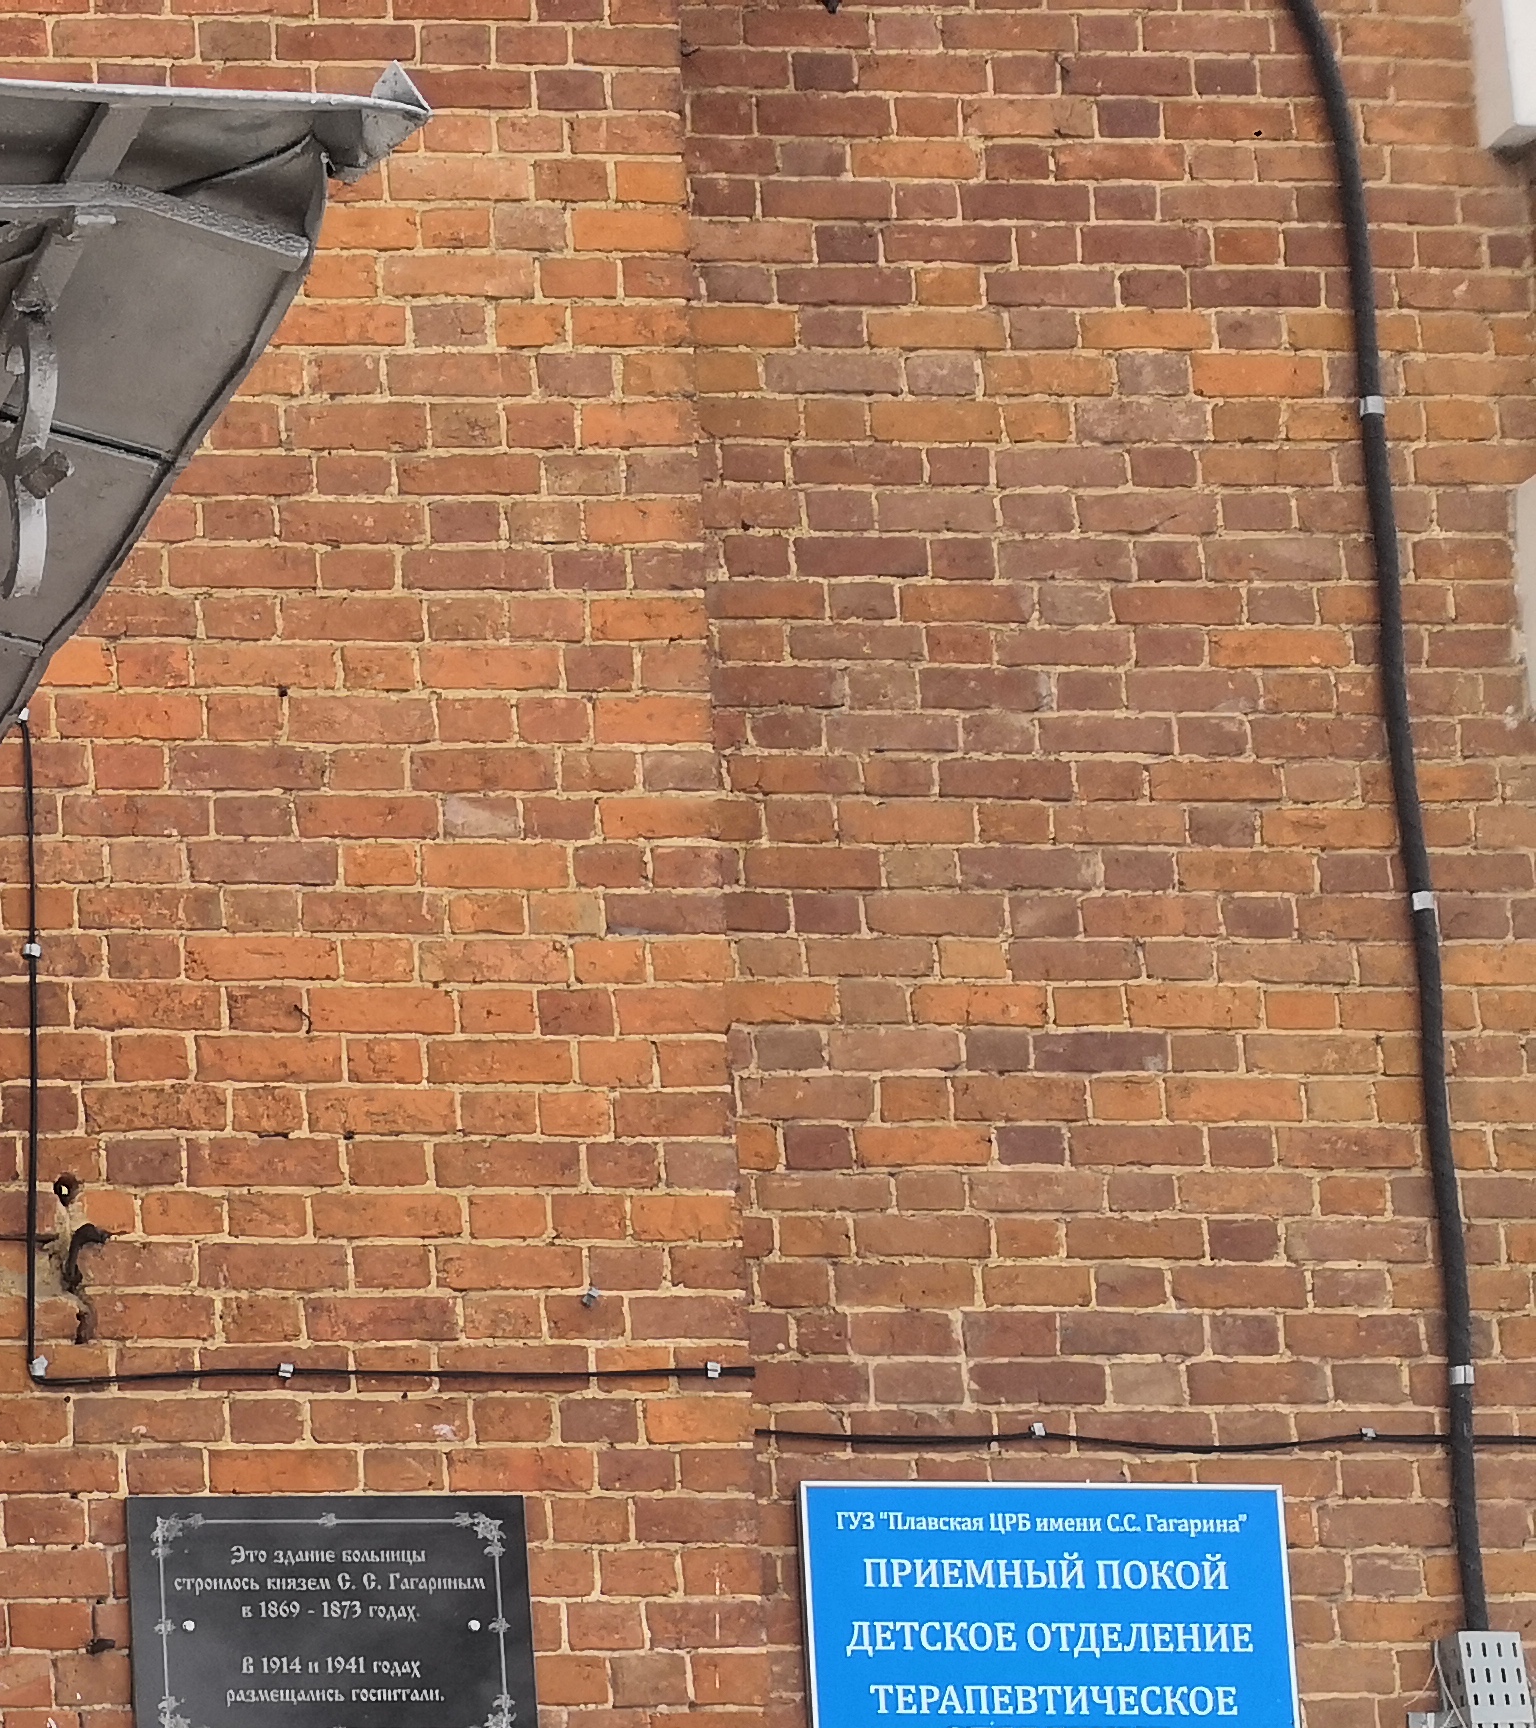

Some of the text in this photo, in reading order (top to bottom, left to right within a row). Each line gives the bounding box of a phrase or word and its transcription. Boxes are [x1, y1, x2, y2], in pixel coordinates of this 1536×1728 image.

[836, 1511, 875, 1530] ГУЗ
[989, 1513, 1031, 1534] ЦРБ
[1035, 1517, 1102, 1532] имени
[1106, 1513, 1141, 1533] С.С.
[230, 1545, 426, 1565] Это здание больницы
[863, 1552, 1229, 1590] ПРИЕМНЫЙ ПОКОЙ
[173, 1572, 486, 1595] строилось князем С. С. Гагариным
[241, 1605, 253, 1618] в
[258, 1600, 301, 1618] 1869
[322, 1600, 362, 1618] 1873
[368, 1604, 421, 1622] годах.
[846, 1621, 1254, 1658] ДЕТСКОЕ ОТДЕЛЕНИЕ
[241, 1656, 422, 1679] В 1914 и 1941 годах
[226, 1688, 345, 1707] размещались
[870, 1685, 1238, 1716] ТЕРАПЕВТИЧЕСКОЕ
